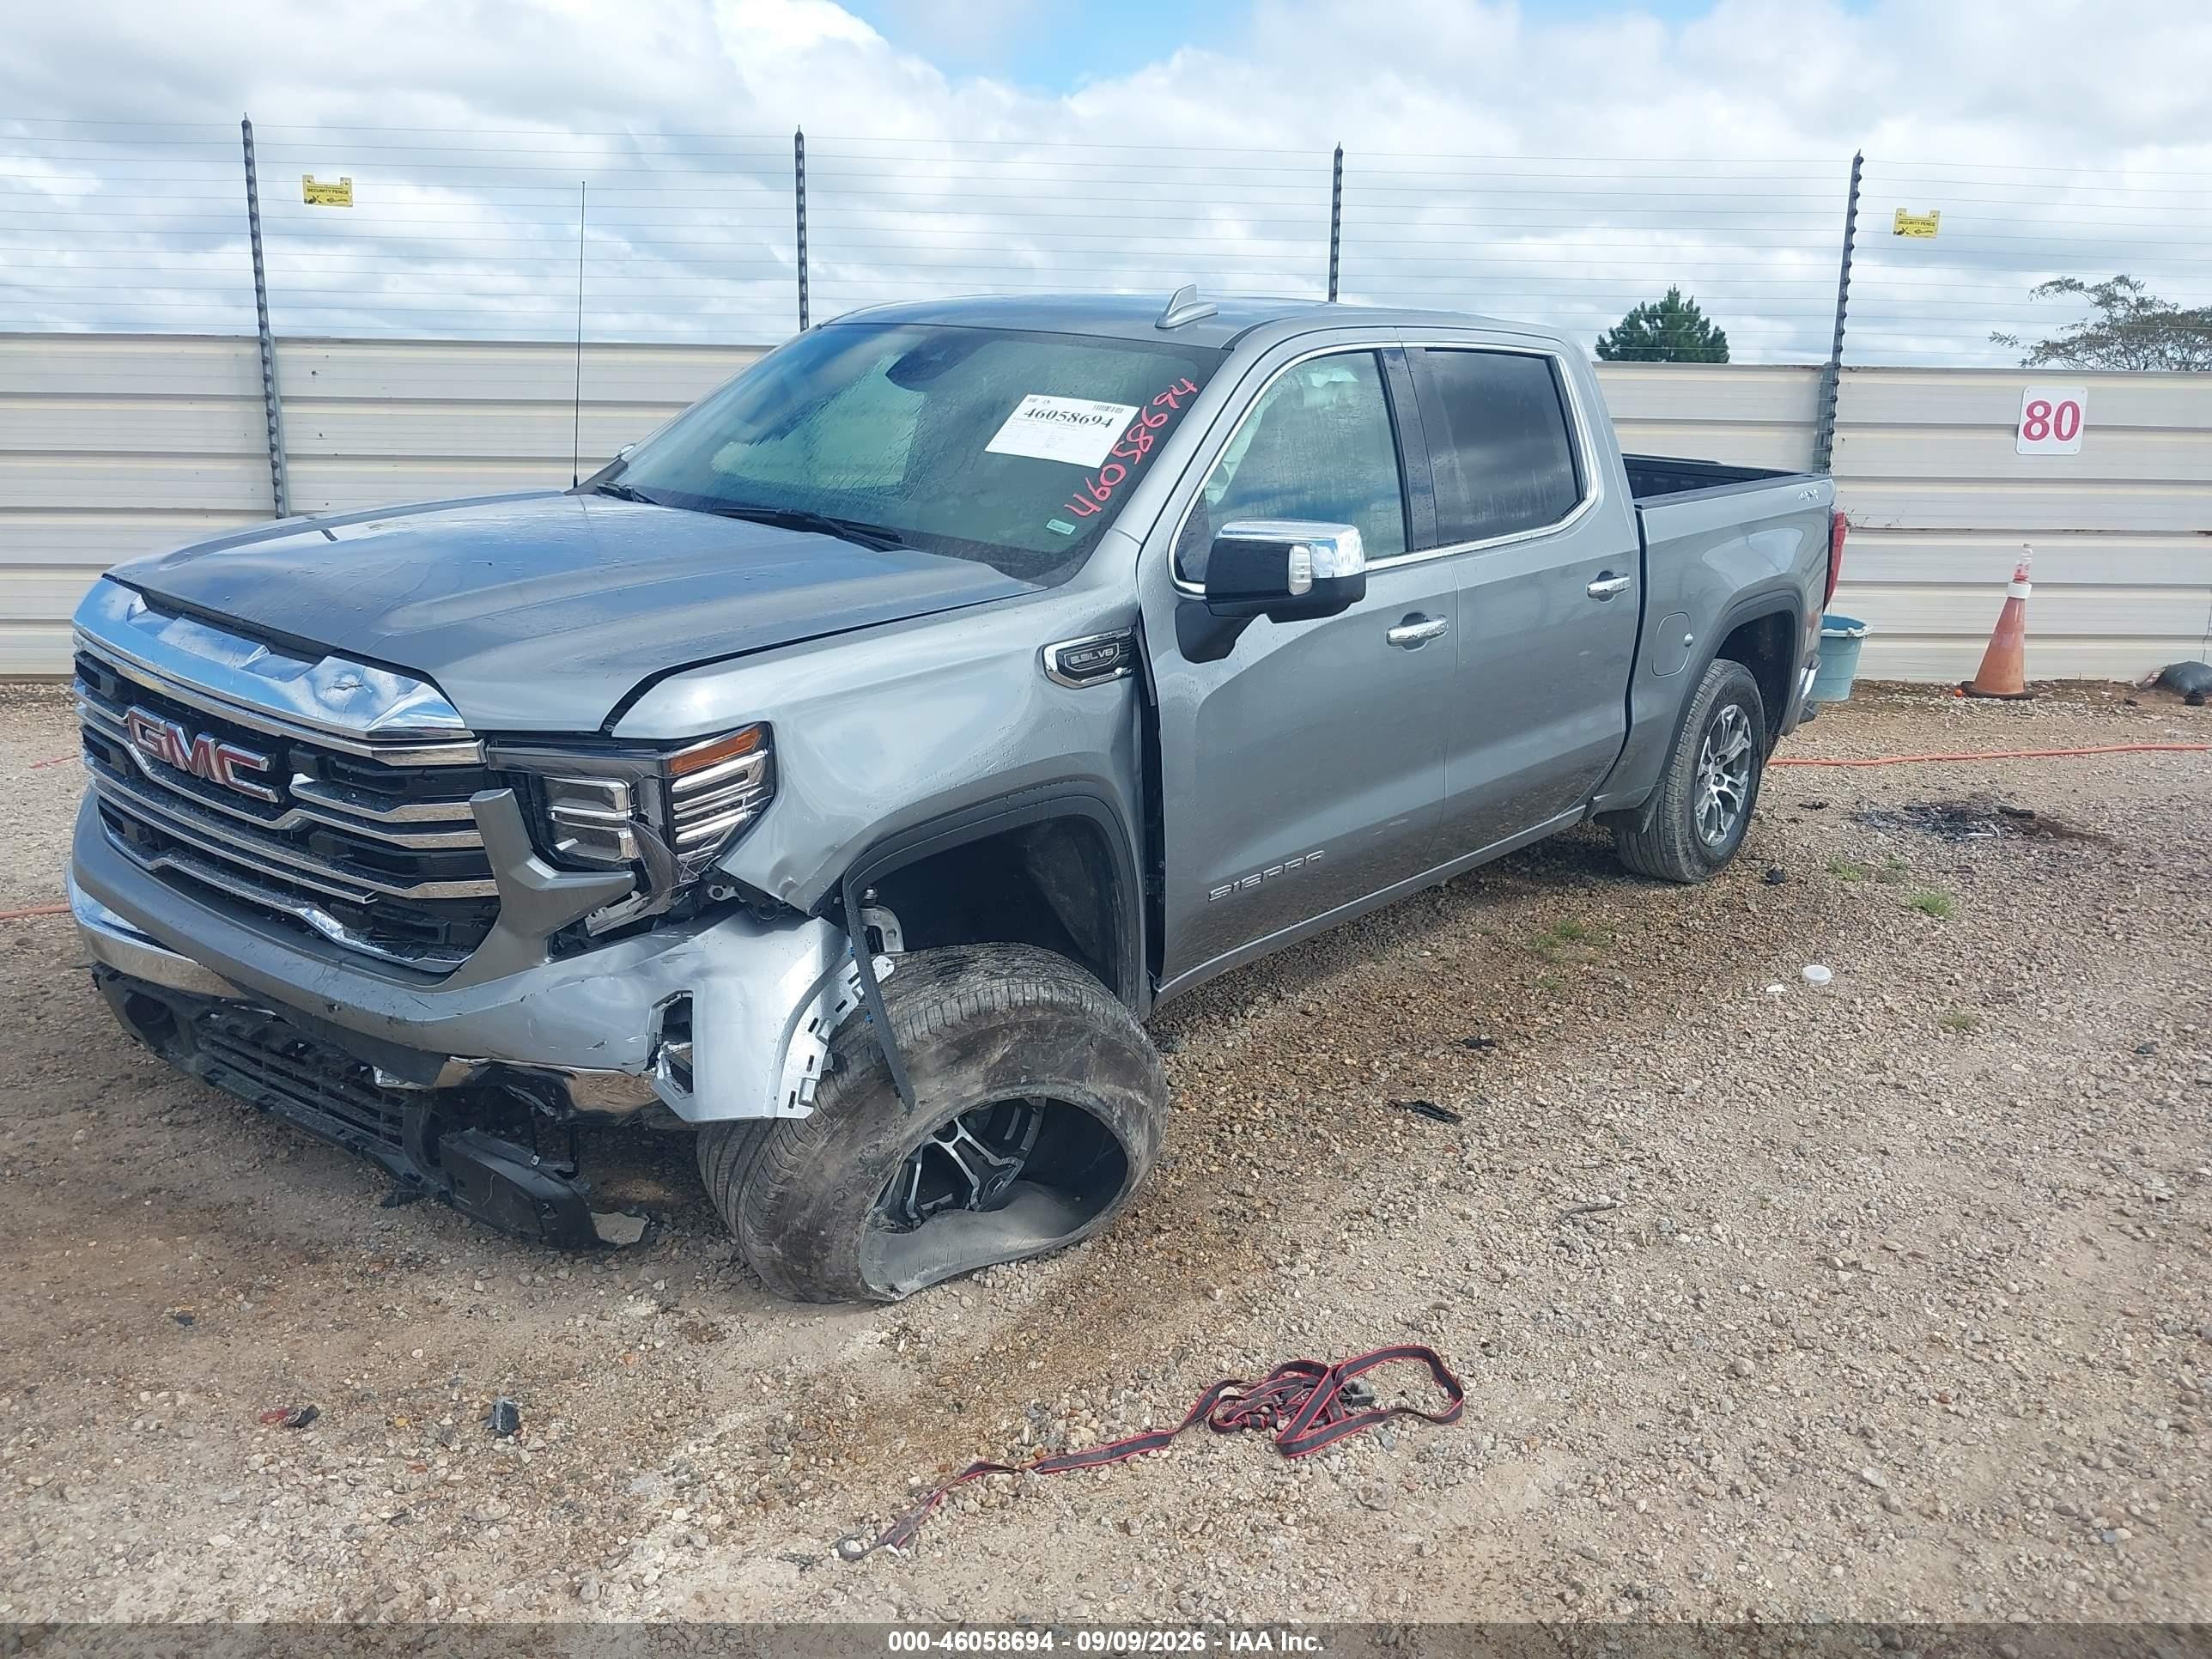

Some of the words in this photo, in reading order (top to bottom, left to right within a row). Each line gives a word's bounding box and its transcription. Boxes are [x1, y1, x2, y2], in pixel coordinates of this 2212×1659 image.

[1024, 407, 1115, 428] 46058694
[2023, 400, 2081, 441] 80
[1064, 378, 1198, 517] 46058694
[127, 704, 279, 803] GMC
[1208, 850, 1325, 902] SIERRA
